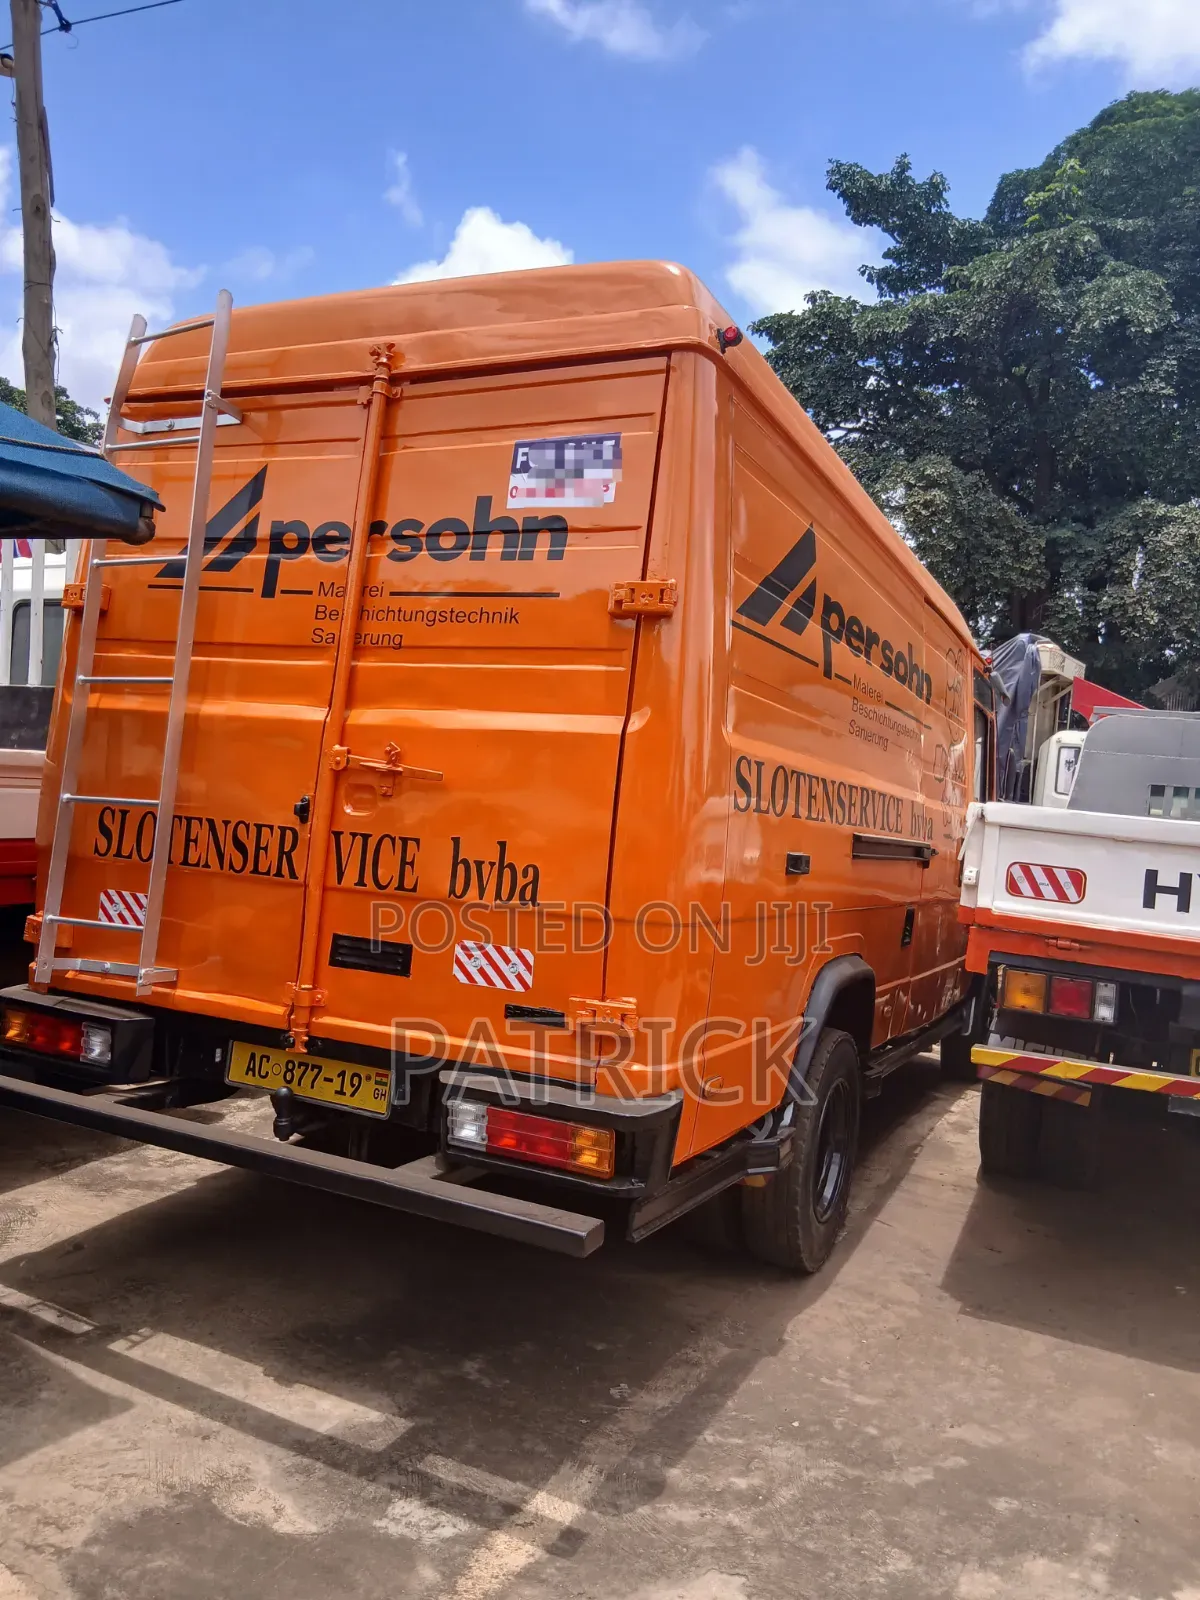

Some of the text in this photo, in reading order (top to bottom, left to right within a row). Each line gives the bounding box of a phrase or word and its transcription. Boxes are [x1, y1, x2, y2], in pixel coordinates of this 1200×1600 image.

[318, 581, 385, 598] Marei
[314, 604, 520, 627] Behichtungstechnik
[311, 627, 403, 650] Saerung
[848, 719, 889, 752] Sanierung
[734, 755, 934, 841] SLOTENSERVICE bvba
[448, 836, 540, 908] bvba
[1143, 868, 1200, 913] H
[244, 1052, 363, 1098] AC 877-19
[373, 1087, 387, 1102] GH
